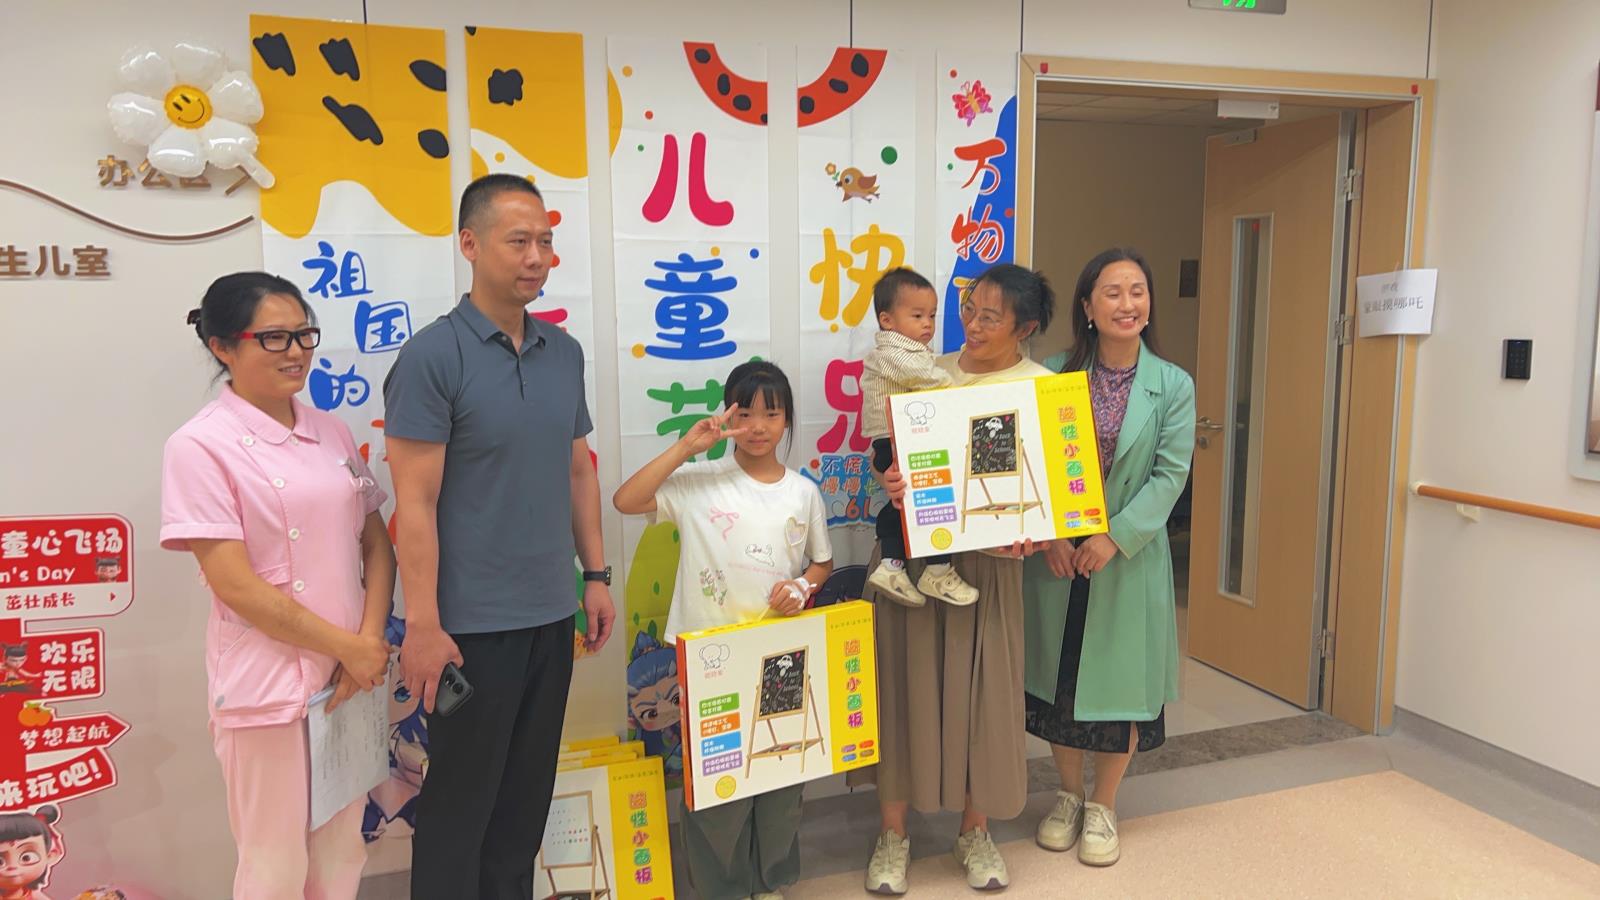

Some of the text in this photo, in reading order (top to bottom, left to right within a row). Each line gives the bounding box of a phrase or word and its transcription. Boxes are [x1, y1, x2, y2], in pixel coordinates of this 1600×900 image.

[953, 137, 1007, 304] 万物
[0, 244, 112, 277] 生儿室
[822, 456, 871, 475] 不慌
[1, 527, 124, 559] 童心飞扬
[37, 566, 76, 582] Day
[6, 591, 76, 611] 茁壮成长
[40, 638, 96, 665] 欢乐
[42, 666, 96, 692] 无限
[19, 722, 111, 751] 梦想起航
